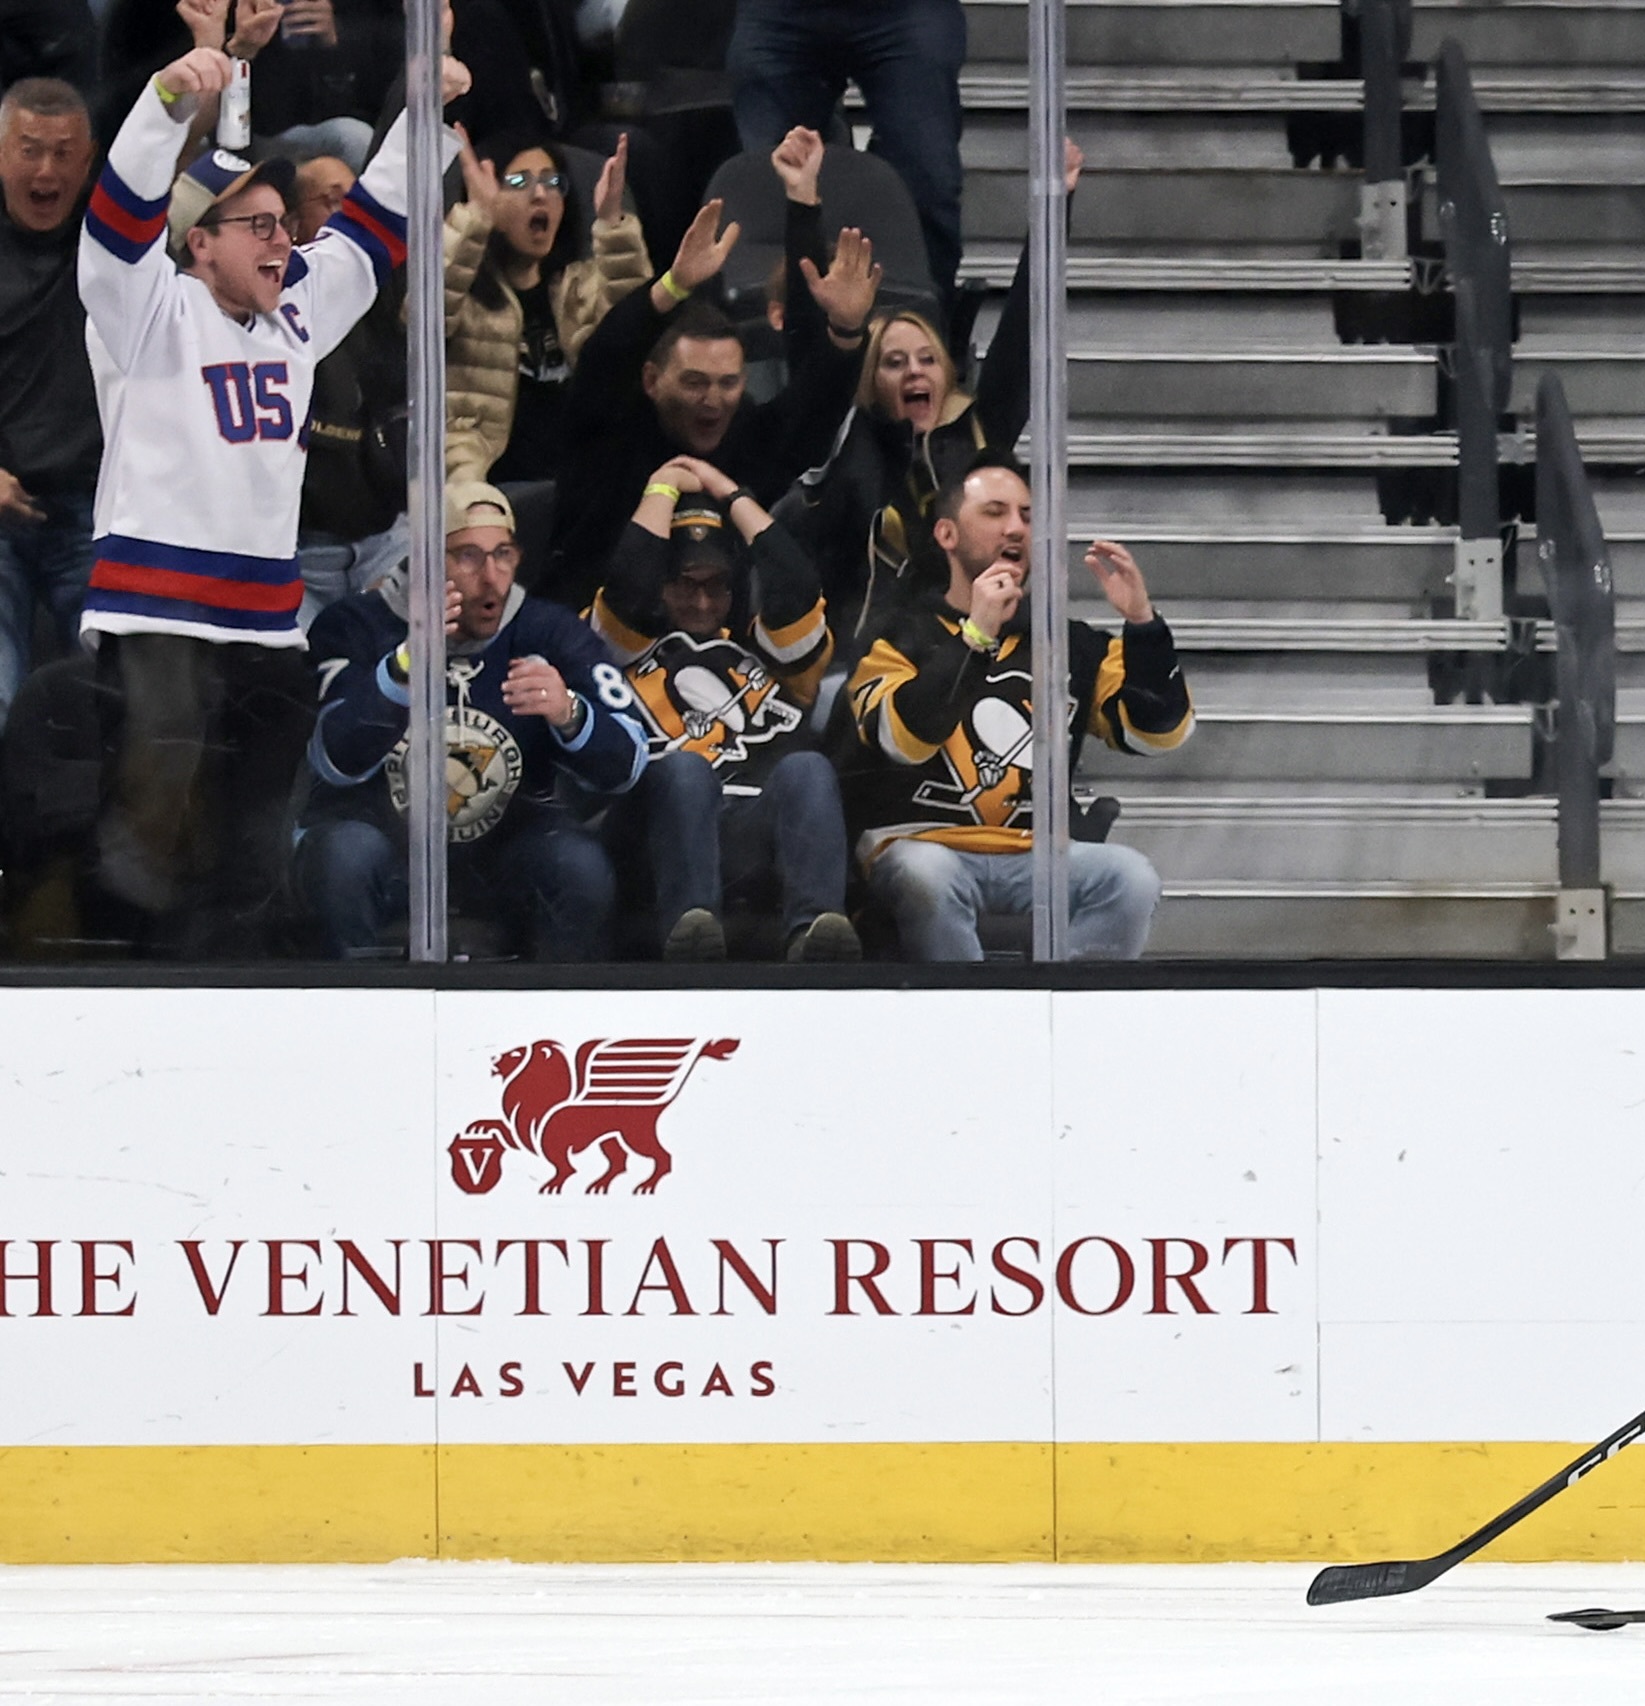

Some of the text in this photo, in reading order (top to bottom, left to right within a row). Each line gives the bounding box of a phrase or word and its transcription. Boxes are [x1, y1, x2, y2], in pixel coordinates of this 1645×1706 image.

[280, 302, 310, 333] C
[201, 361, 295, 444] US
[592, 663, 632, 709] 8
[458, 1147, 495, 1186] V
[176, 1236, 786, 1317] VENETIAN
[824, 1237, 1298, 1316] RESORT
[413, 1361, 776, 1397] LAS VEGAS
